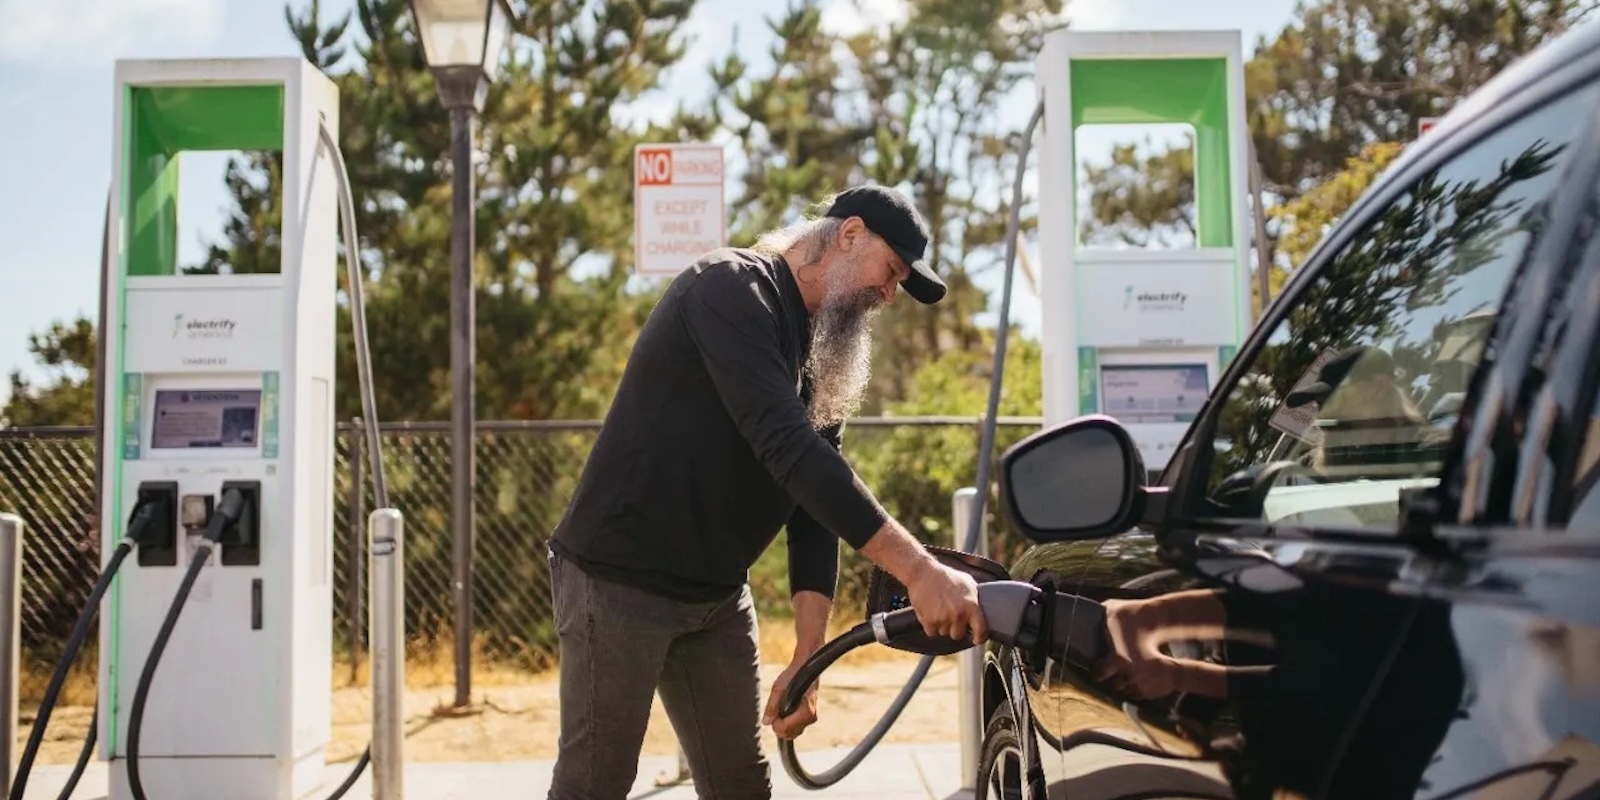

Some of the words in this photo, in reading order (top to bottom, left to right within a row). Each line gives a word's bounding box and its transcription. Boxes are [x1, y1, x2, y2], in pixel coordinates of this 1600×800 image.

[640, 153, 670, 181] NO
[676, 160, 721, 176] PARKING
[655, 200, 708, 215] EXCEPT
[661, 220, 701, 235] WHILE
[646, 241, 717, 255] CHARGING
[1137, 291, 1188, 303] electrify
[186, 318, 236, 330] electrify
